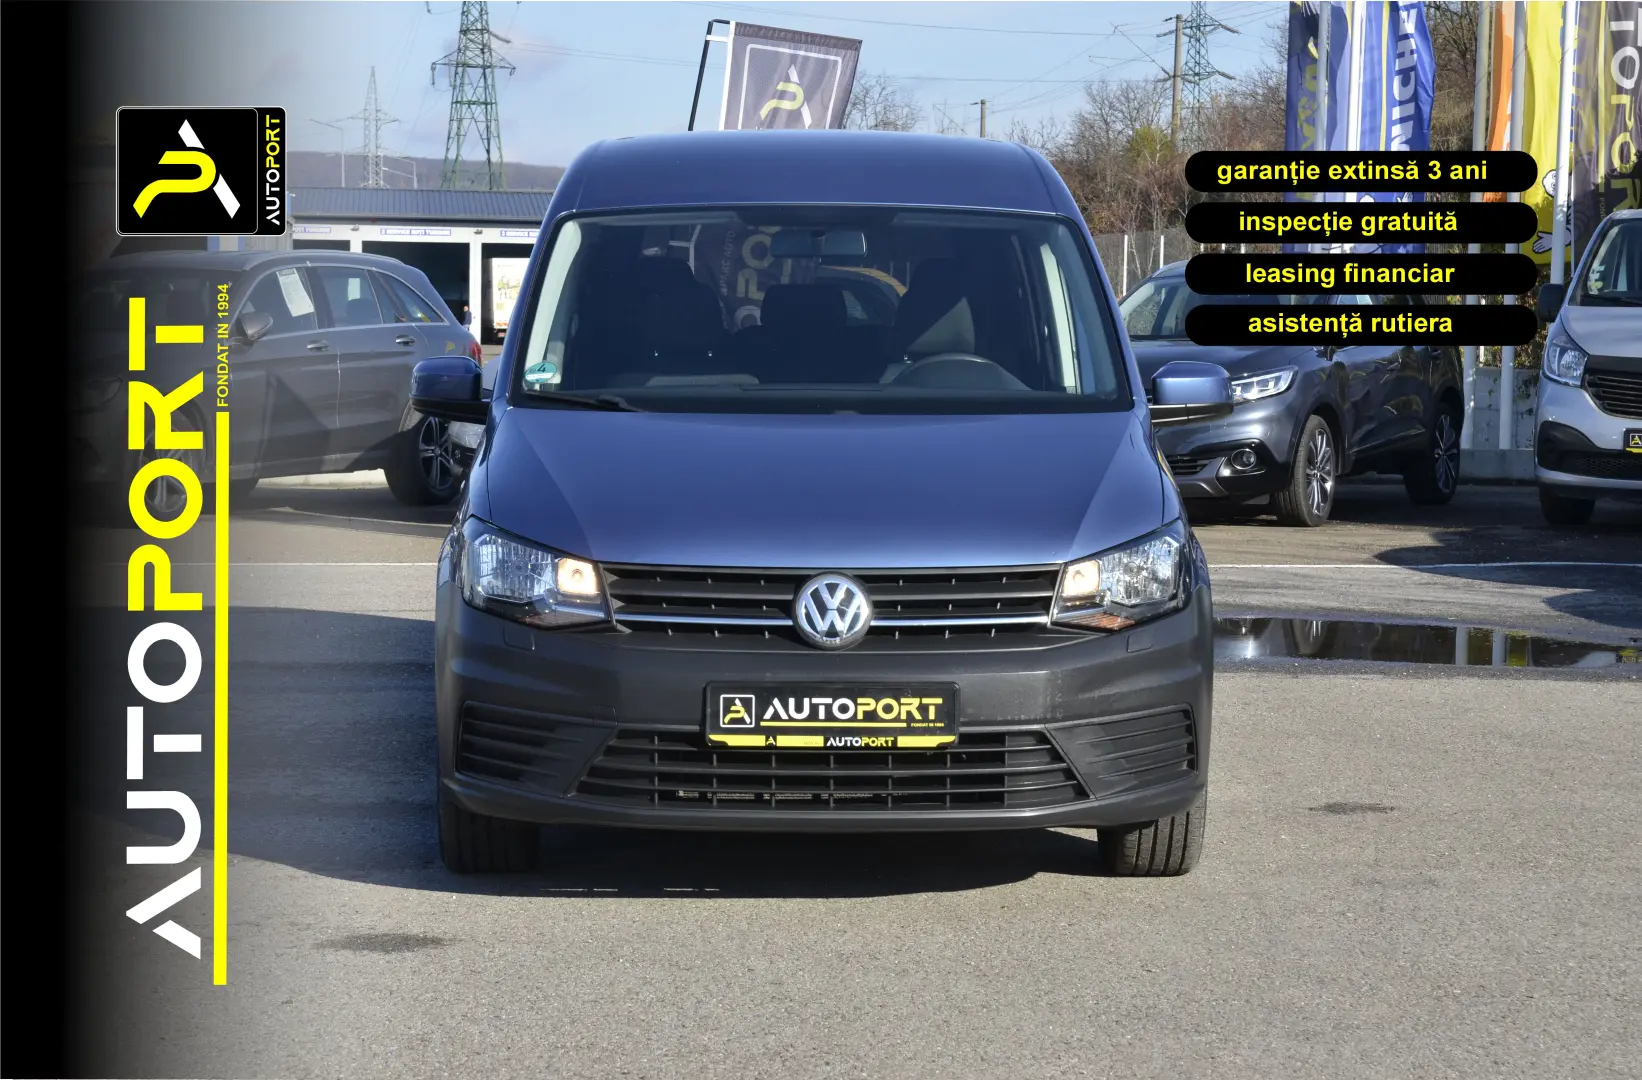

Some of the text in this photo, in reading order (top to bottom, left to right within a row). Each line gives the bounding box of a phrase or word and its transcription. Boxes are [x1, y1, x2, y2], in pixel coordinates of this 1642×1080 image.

[1391, 1, 1418, 151] NICHE
[537, 363, 546, 373] 4
[763, 697, 943, 720] AUTOPORT
[826, 736, 895, 747] AUTOPORT
